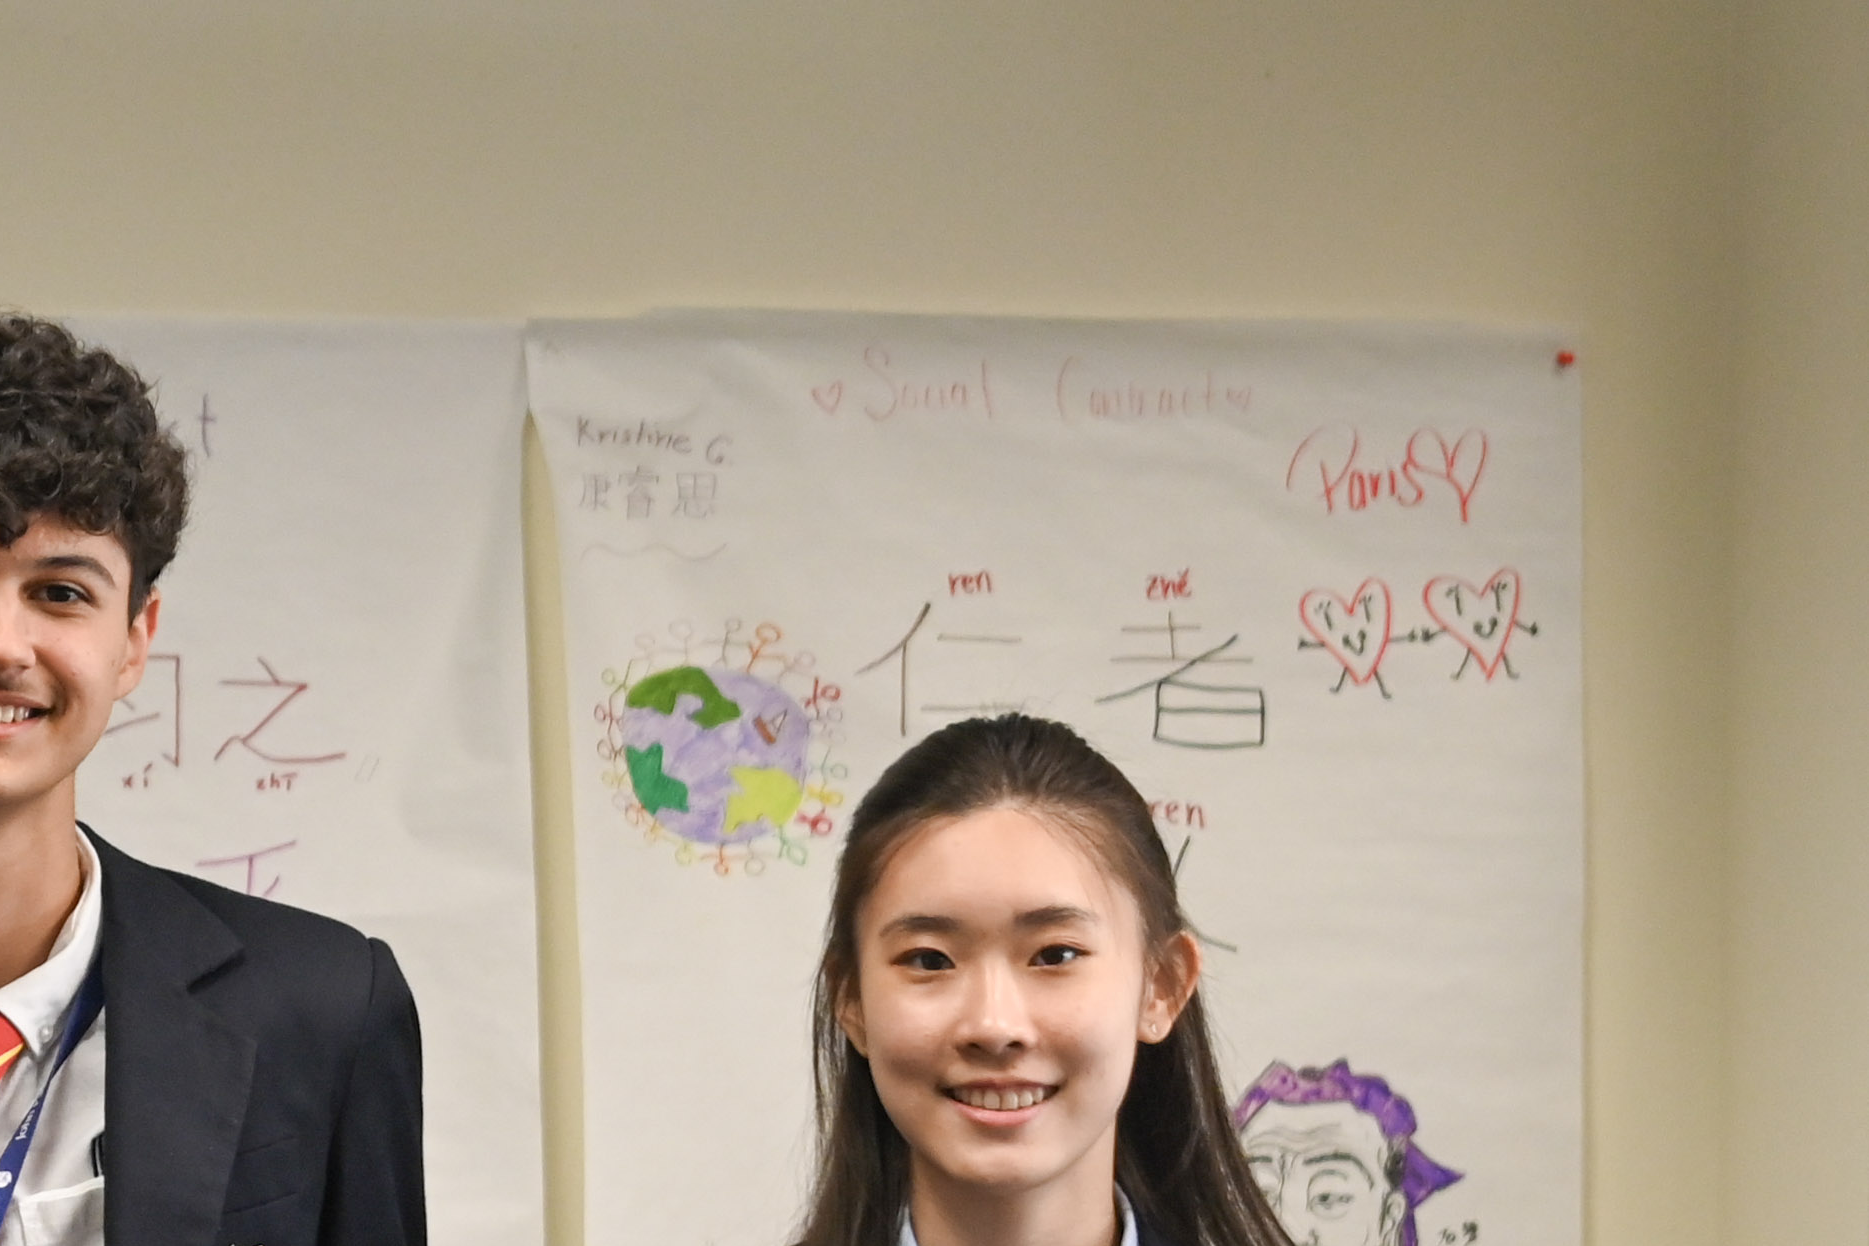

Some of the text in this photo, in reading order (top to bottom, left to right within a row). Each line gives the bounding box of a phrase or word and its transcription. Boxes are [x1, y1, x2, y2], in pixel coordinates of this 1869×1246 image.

[577, 414, 692, 454] Kristine
[1286, 425, 1423, 515] Paris
[214, 656, 347, 763] 之
[1094, 608, 1266, 750] 者
